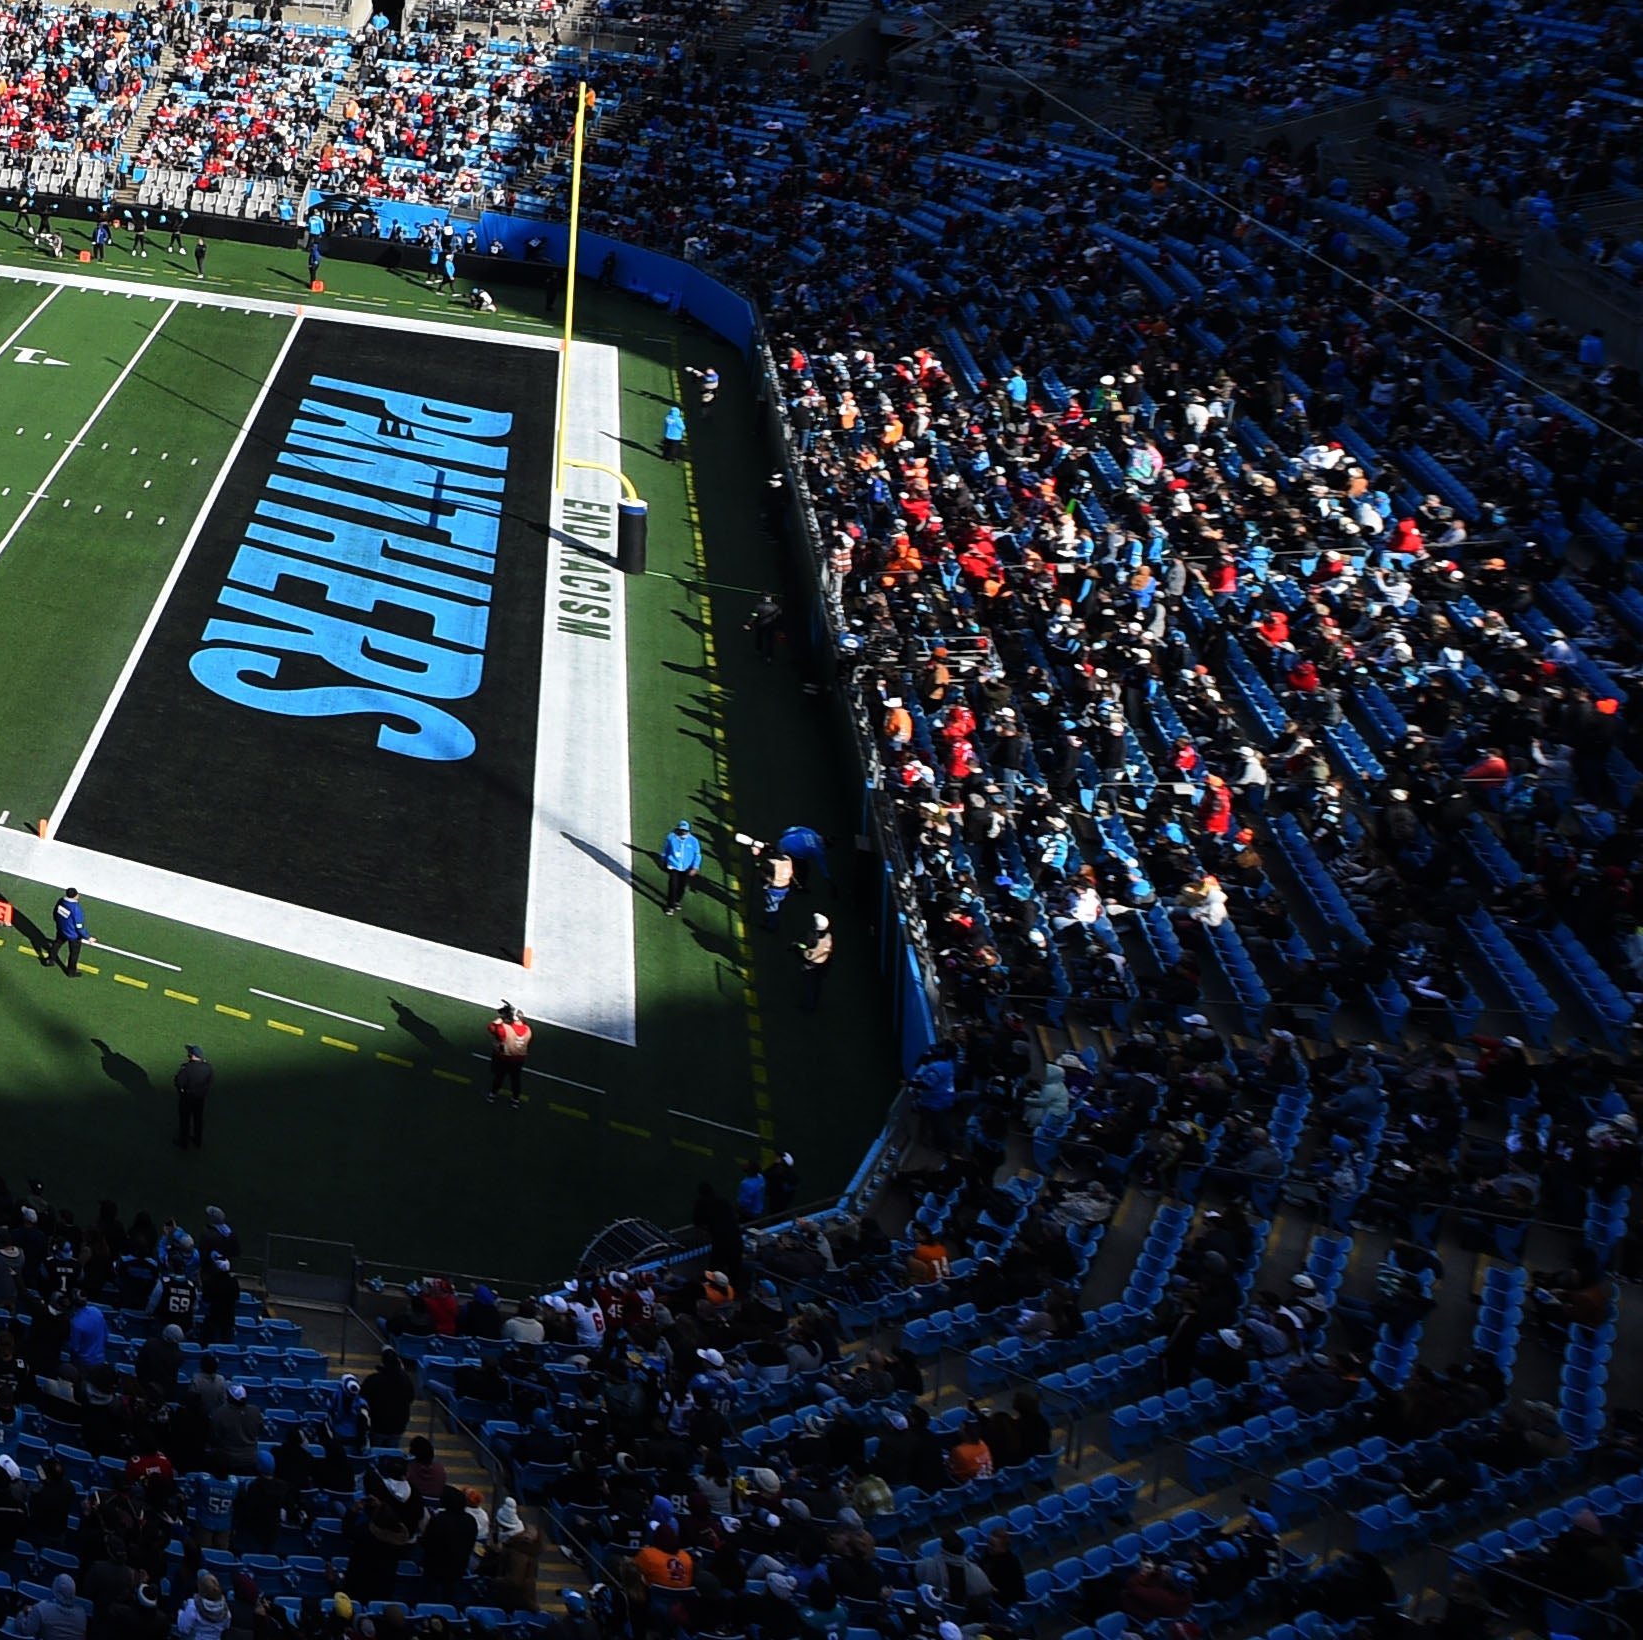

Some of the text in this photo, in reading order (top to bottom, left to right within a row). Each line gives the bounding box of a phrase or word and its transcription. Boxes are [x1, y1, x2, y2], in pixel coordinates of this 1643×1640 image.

[188, 374, 514, 762] PANTHERS
[556, 497, 612, 641] END RACISM
[60, 1275, 68, 1292] 1
[169, 1296, 191, 1313] 69
